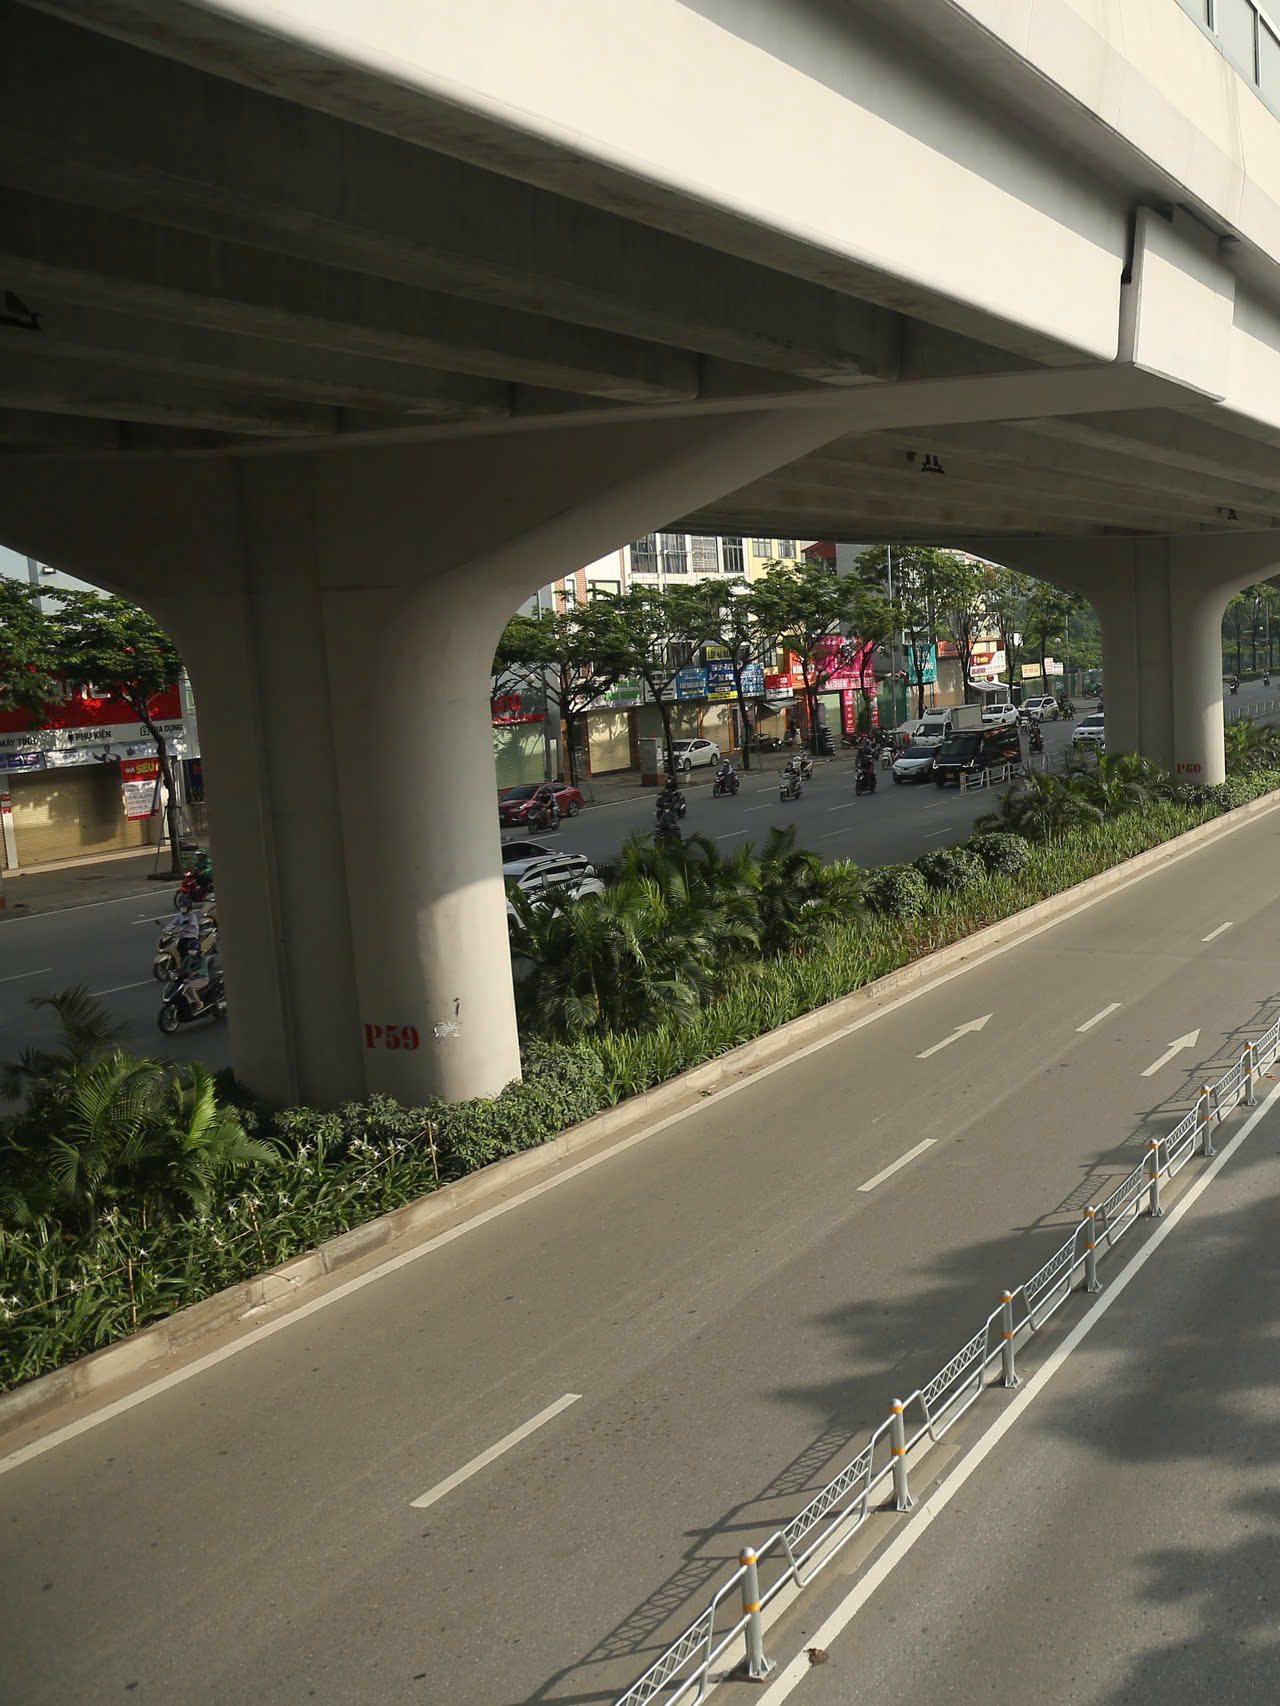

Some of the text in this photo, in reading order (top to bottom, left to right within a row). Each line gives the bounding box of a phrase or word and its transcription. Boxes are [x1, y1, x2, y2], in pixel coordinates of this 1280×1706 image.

[75, 731, 92, 742] PHỤ
[93, 729, 112, 740] KIỆN
[164, 723, 183, 734] DỤNG
[1175, 763, 1201, 774] P60
[364, 1023, 420, 1050] P59
